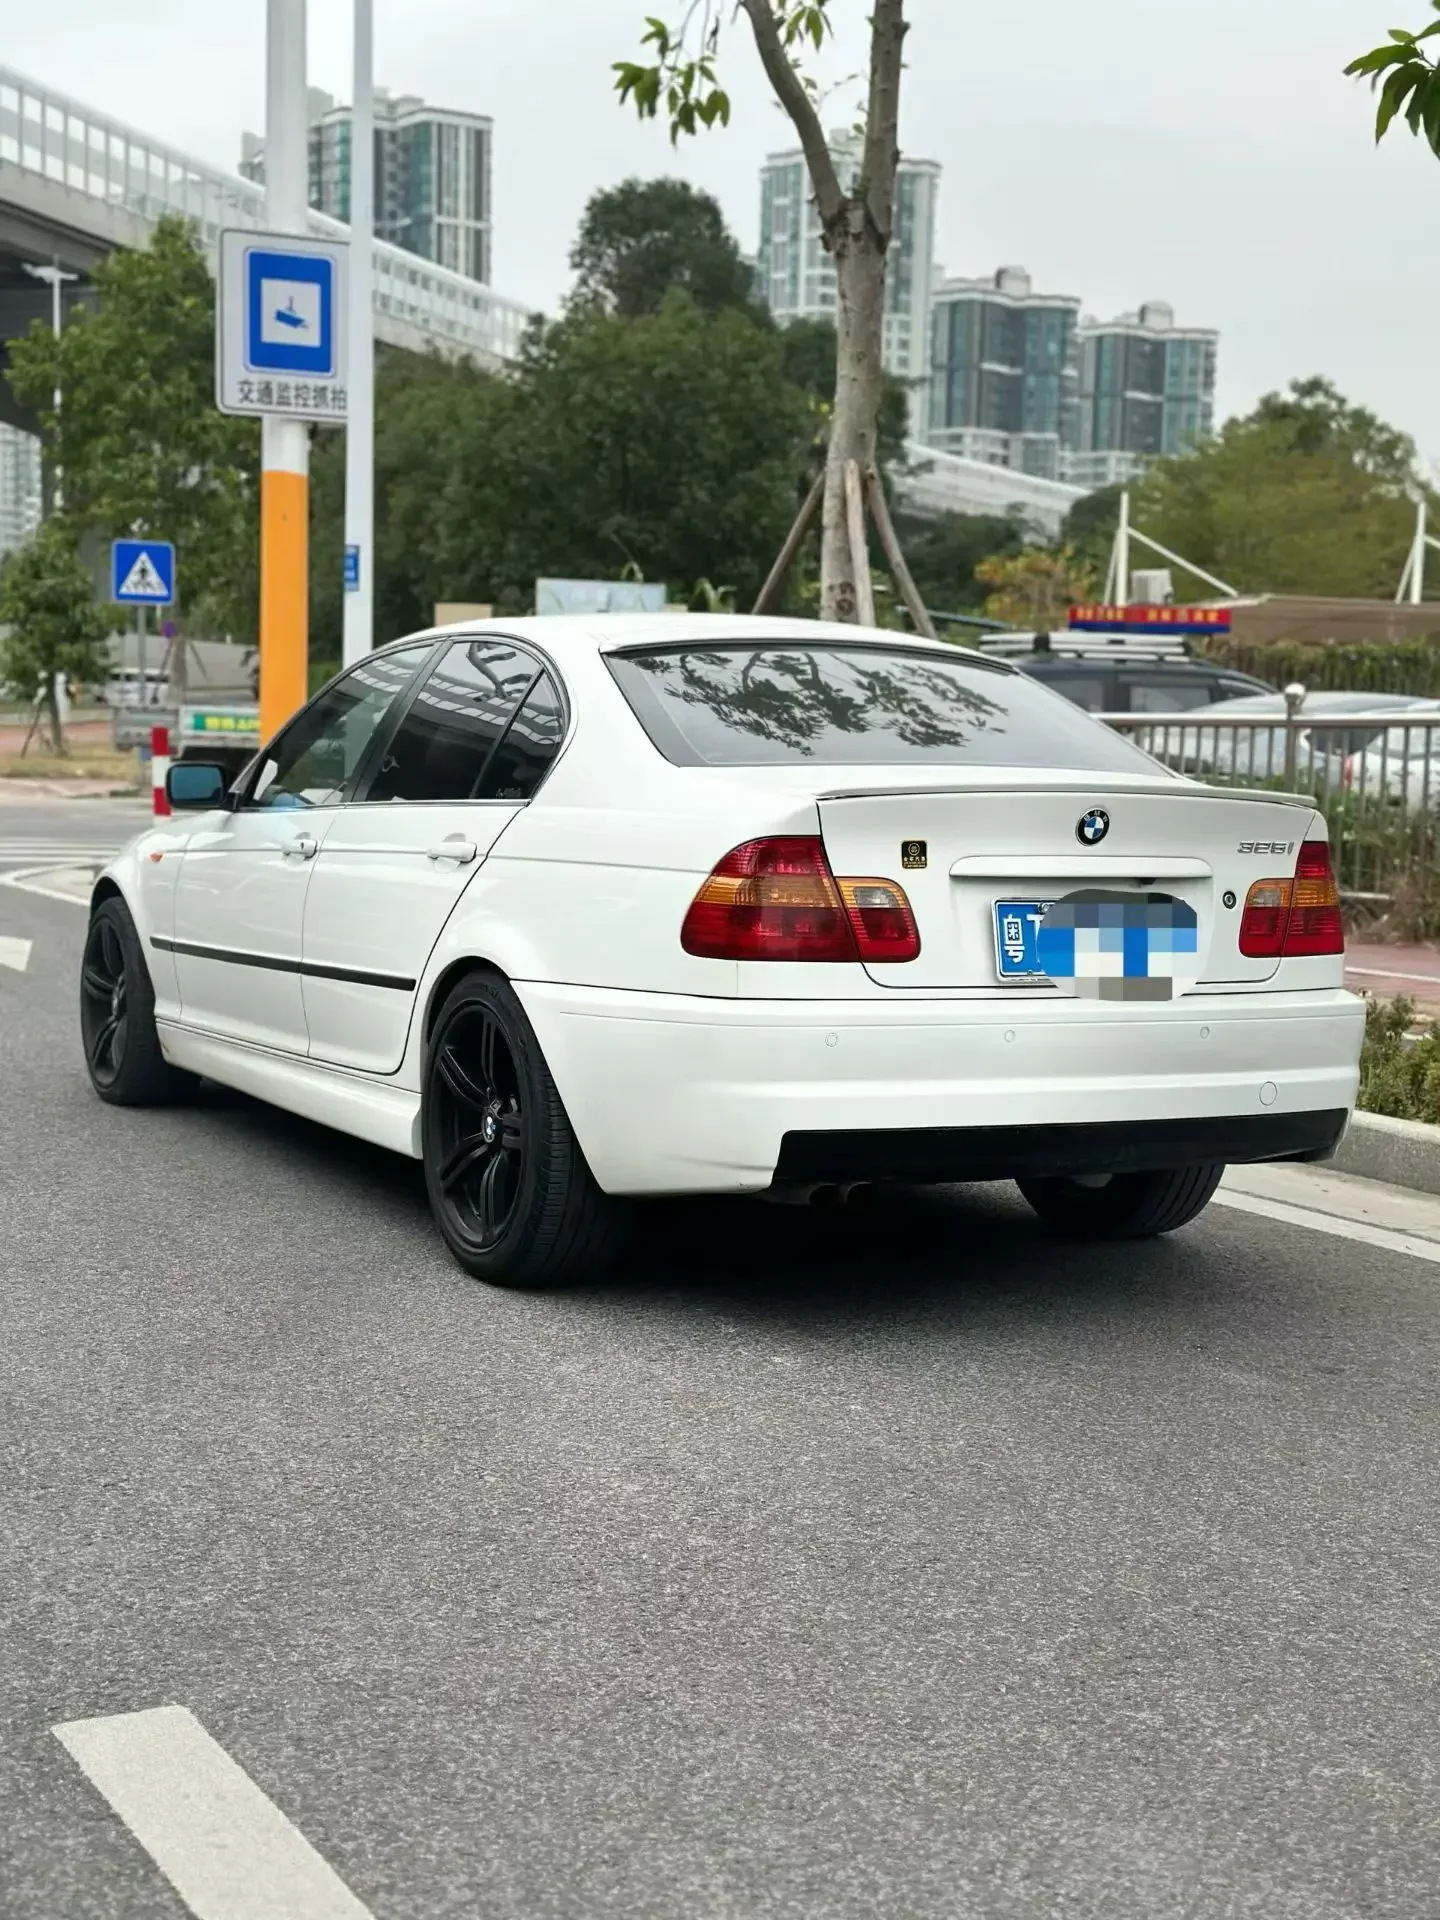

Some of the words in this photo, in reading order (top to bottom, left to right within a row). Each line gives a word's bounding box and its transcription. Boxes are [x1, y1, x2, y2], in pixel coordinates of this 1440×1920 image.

[237, 379, 348, 411] 交通监控抓拍
